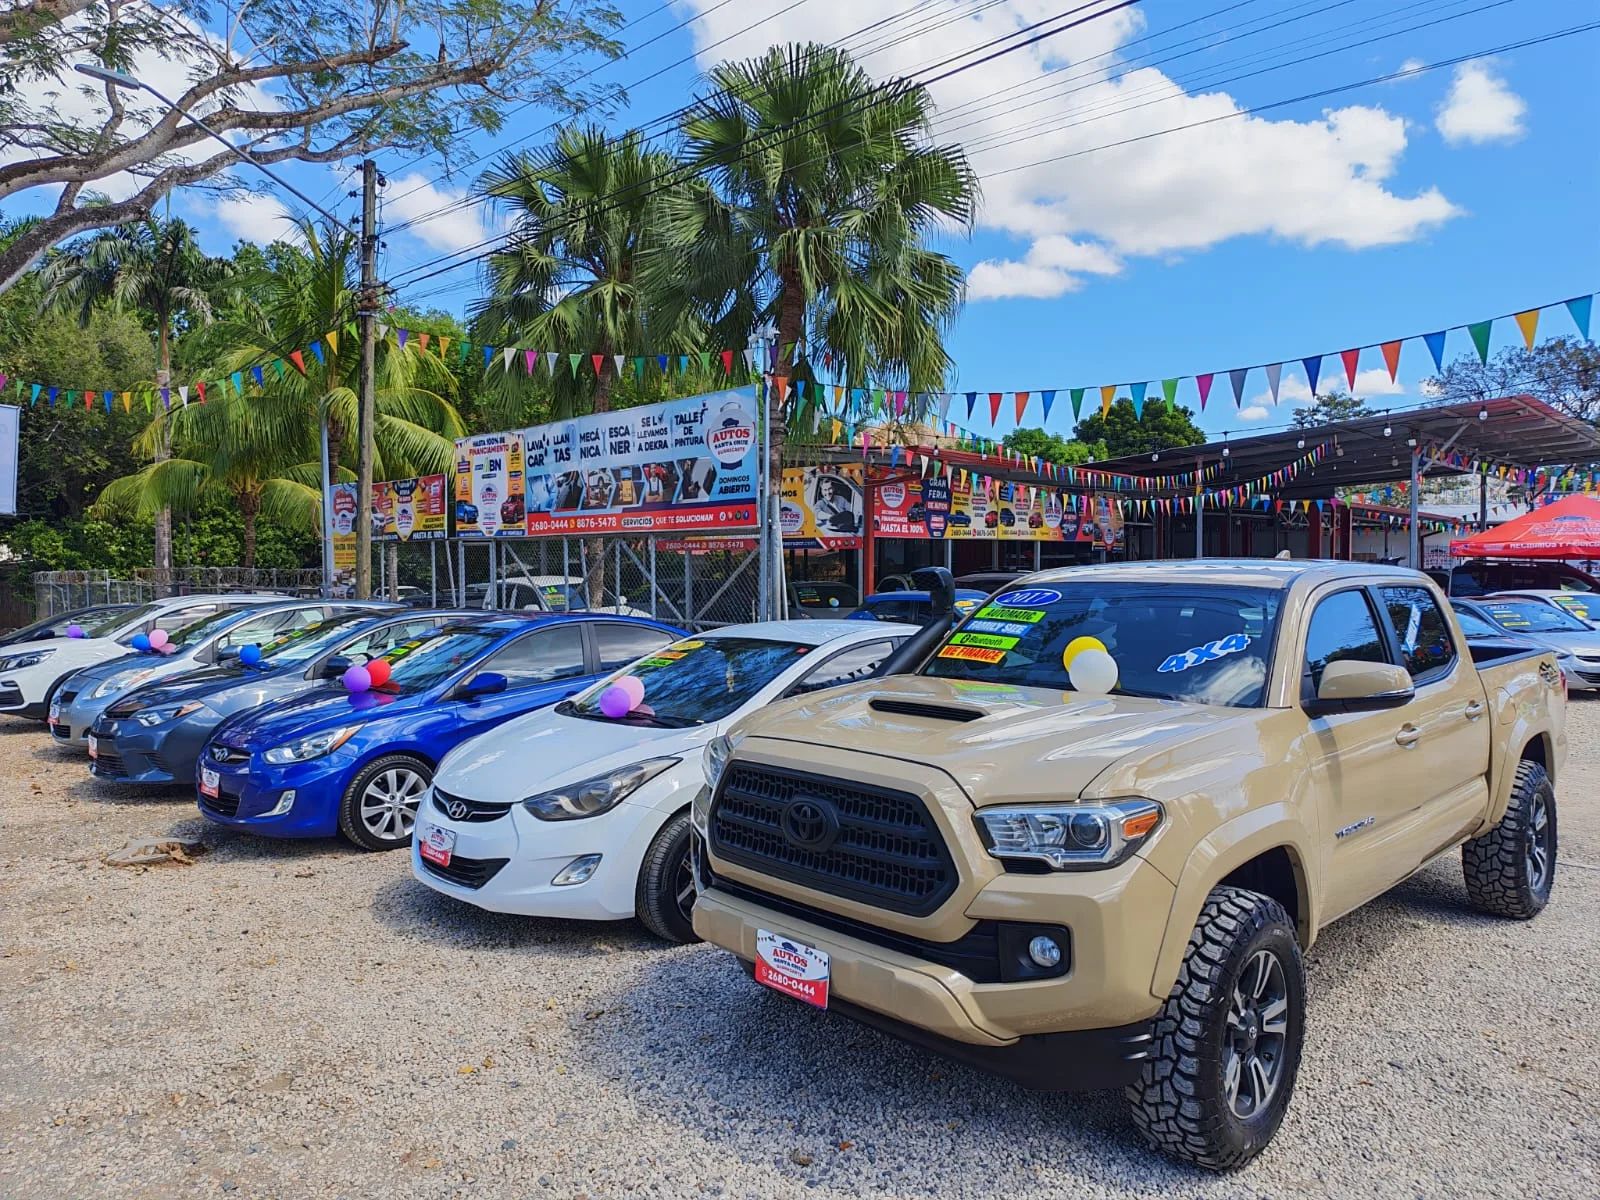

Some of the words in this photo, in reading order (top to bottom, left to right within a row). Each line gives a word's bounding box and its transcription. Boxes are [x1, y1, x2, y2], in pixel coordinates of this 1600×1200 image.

[641, 416, 651, 427] SE
[608, 425, 630, 438] ESCA
[637, 427, 668, 440] LLEVAMOS
[683, 425, 694, 436] DE
[713, 429, 750, 443] AUTOS
[527, 439, 544, 452] LAVA
[553, 433, 570, 446] LLAN
[645, 440, 668, 452] DEKRA
[674, 436, 705, 448] PINTURA
[580, 445, 601, 459] NICA
[609, 441, 630, 455] NER
[527, 453, 544, 467] CAR
[554, 448, 571, 463] TAS
[489, 458, 502, 471] BN
[719, 475, 750, 484] DOMINGOS
[929, 479, 946, 487] GRAN
[718, 484, 751, 495] ABIERTO
[780, 490, 797, 498] MOS
[928, 489, 947, 499] FERIA
[531, 519, 569, 531] 2680-0444
[576, 517, 617, 528] 8876-5478
[623, 517, 653, 527] SERVICIOS
[655, 517, 668, 525] QUE
[668, 516, 675, 524] TE
[675, 514, 714, 523] SOLUCIONAN
[880, 523, 900, 532] HASTA
[1003, 592, 1053, 603] 2017
[986, 609, 1037, 620] AUTOMATIC
[967, 620, 1002, 632] FAMILY
[968, 635, 1004, 646] Bluetooth
[960, 647, 1003, 661] FINANCE
[773, 948, 808, 967] AUTOS
[768, 970, 815, 996] 2680-0444
